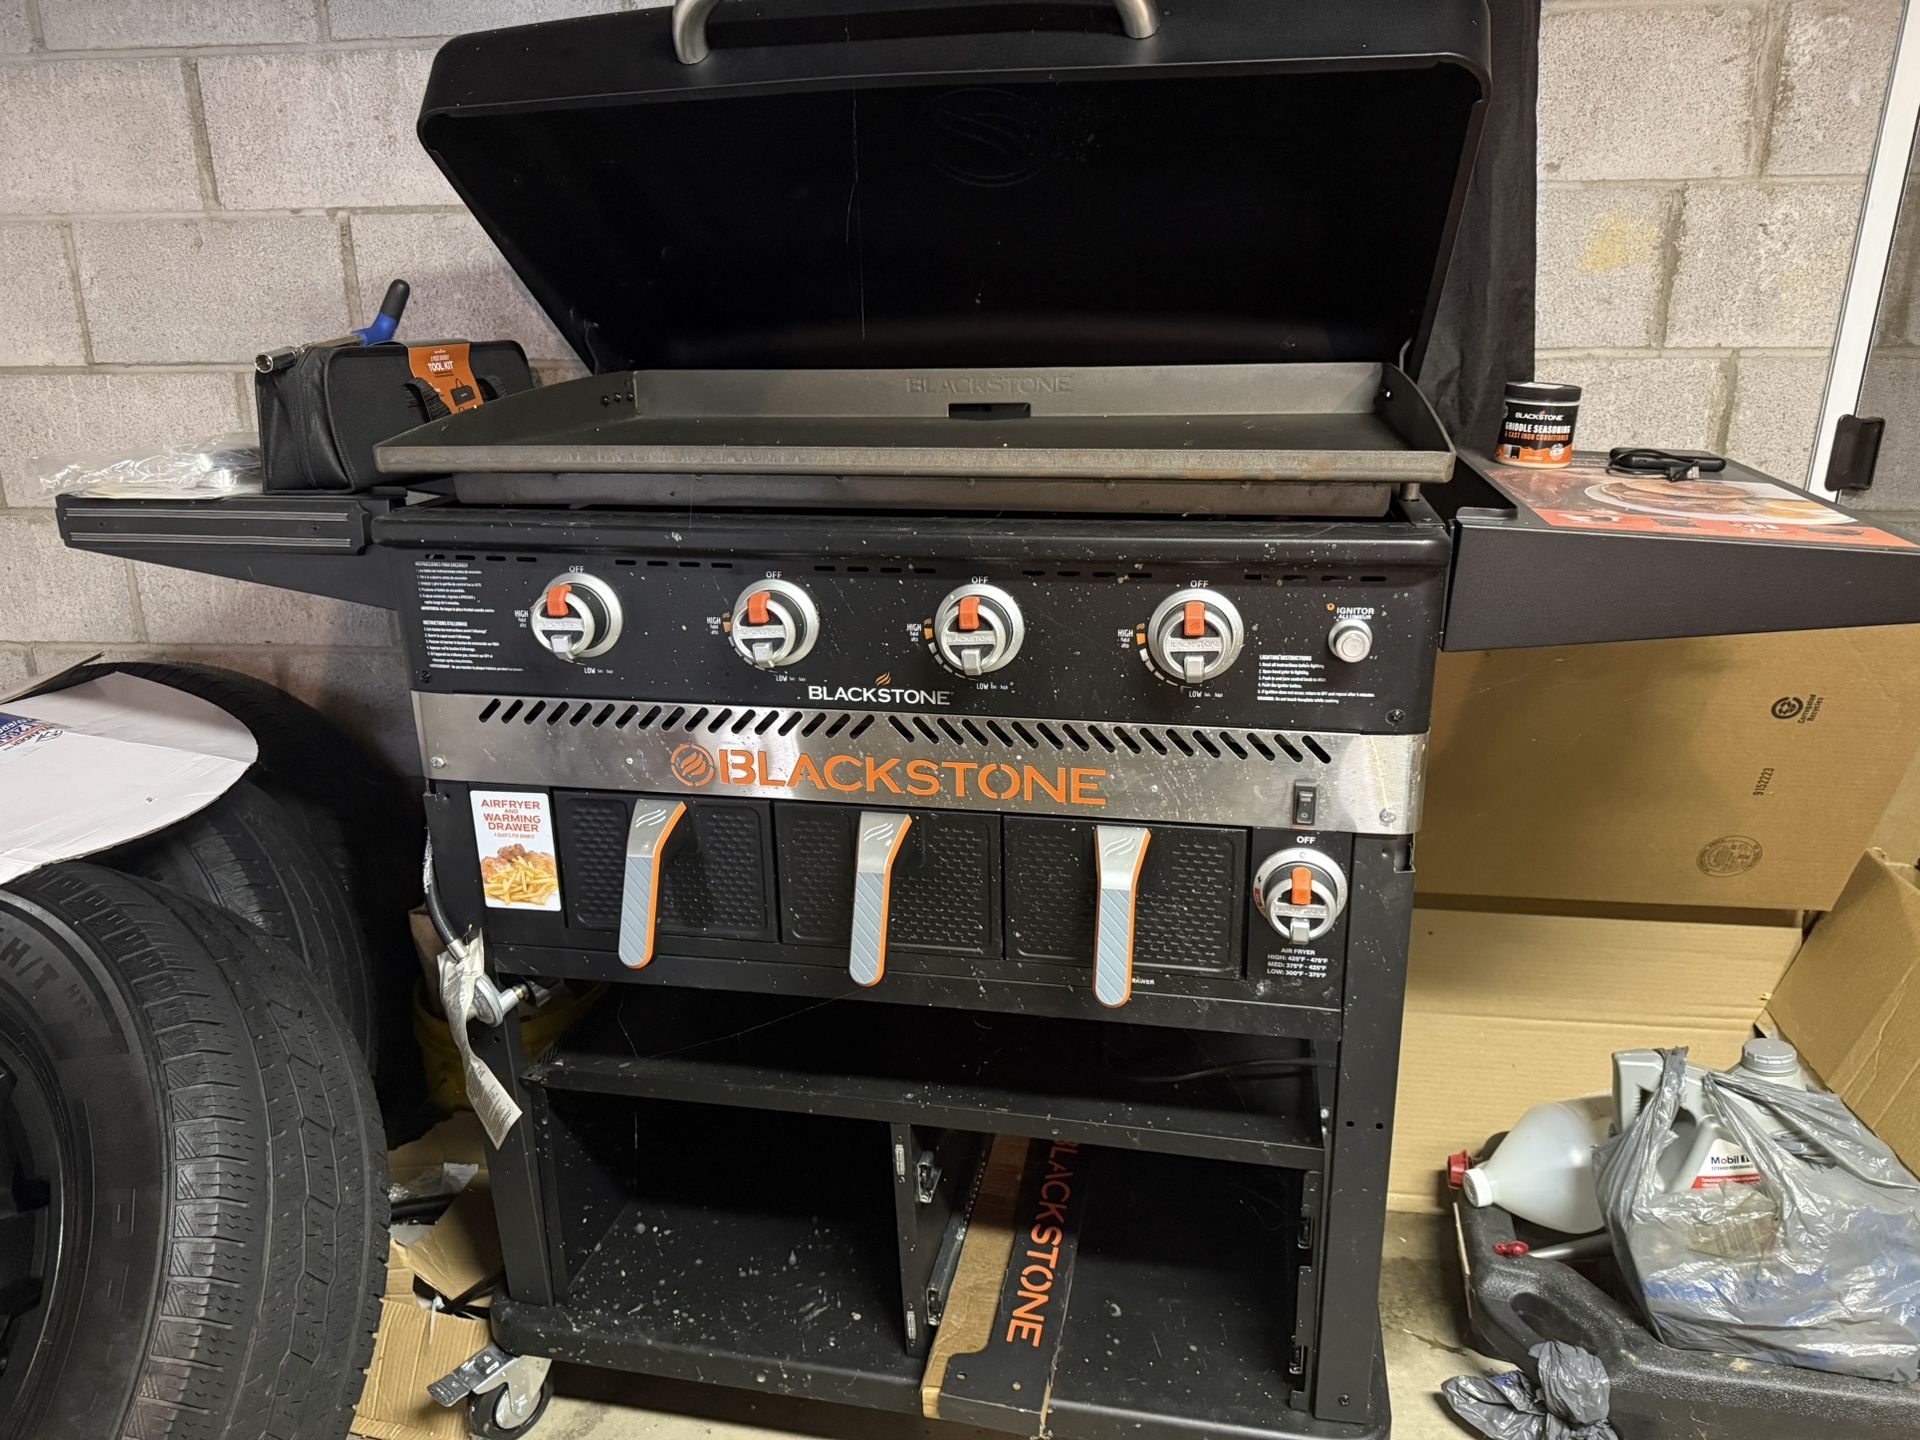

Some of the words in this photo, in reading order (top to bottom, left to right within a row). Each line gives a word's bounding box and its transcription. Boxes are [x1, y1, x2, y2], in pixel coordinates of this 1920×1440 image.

[428, 361, 444, 372] TOOL
[444, 361, 454, 370] KIT
[906, 376, 1074, 395] BLACKSTONE
[1515, 412, 1564, 421] BLACKSTONE
[1533, 424, 1571, 434] SEASONING
[766, 570, 782, 578] OFF
[971, 576, 989, 584] OFF
[1190, 580, 1209, 588] OFF
[514, 610, 529, 618] HIGH
[1336, 606, 1375, 615] IGNITOR
[808, 686, 950, 706] BLACKSTONE
[1807, 697, 1824, 722] Recycles
[718, 749, 1106, 806] BLACKSTONE
[1752, 767, 1775, 796] 9152223
[481, 800, 540, 810] AIRFRYER
[484, 813, 541, 824] WARMING
[488, 822, 539, 832] DRAWER
[1296, 836, 1316, 844] OFF
[1132, 976, 1155, 985] RAWER
[1711, 1156, 1739, 1164] Mobil
